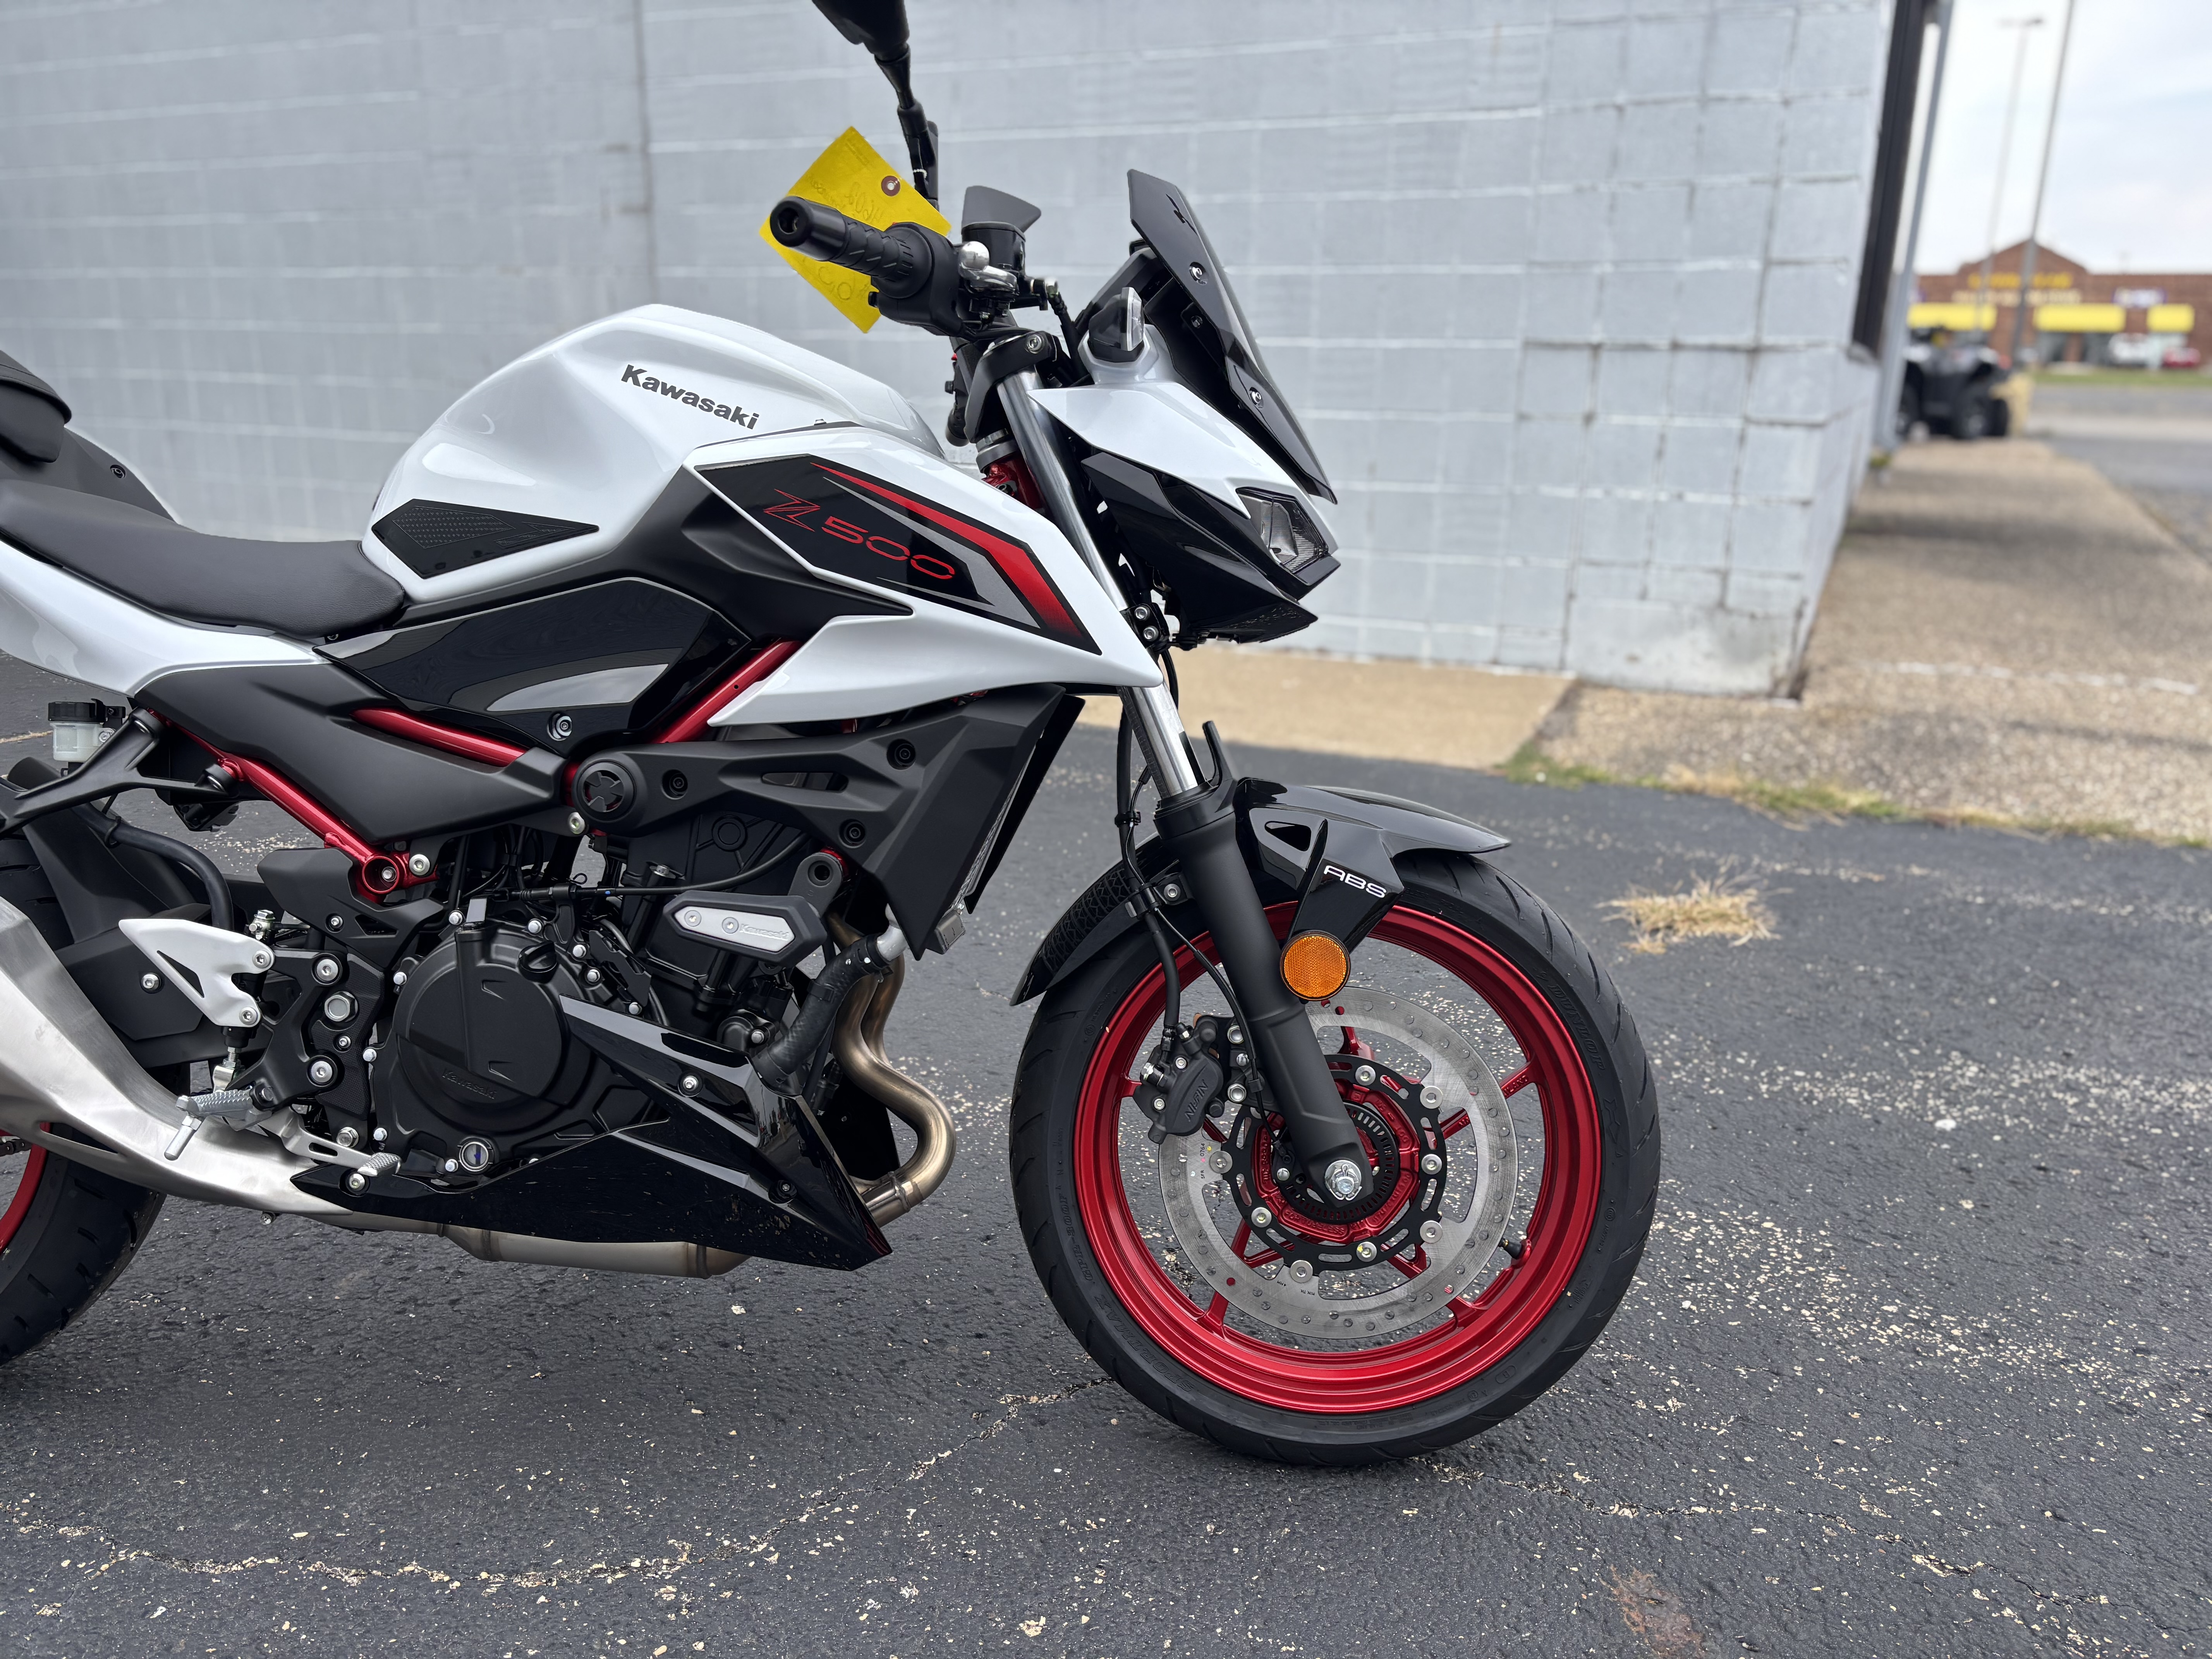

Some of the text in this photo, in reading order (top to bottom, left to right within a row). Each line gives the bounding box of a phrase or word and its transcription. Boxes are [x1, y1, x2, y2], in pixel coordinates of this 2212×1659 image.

[621, 364, 759, 429] Kawasaki
[821, 516, 956, 579] 500
[1324, 865, 1387, 898] ABS
[739, 924, 790, 941] Kawasaki
[1548, 983, 1605, 1072] DUNLOP
[443, 1067, 497, 1100] Kawasaki
[1058, 1192, 1094, 1283] GPR-300F
[1094, 1293, 1196, 1394] SPORTMAX
